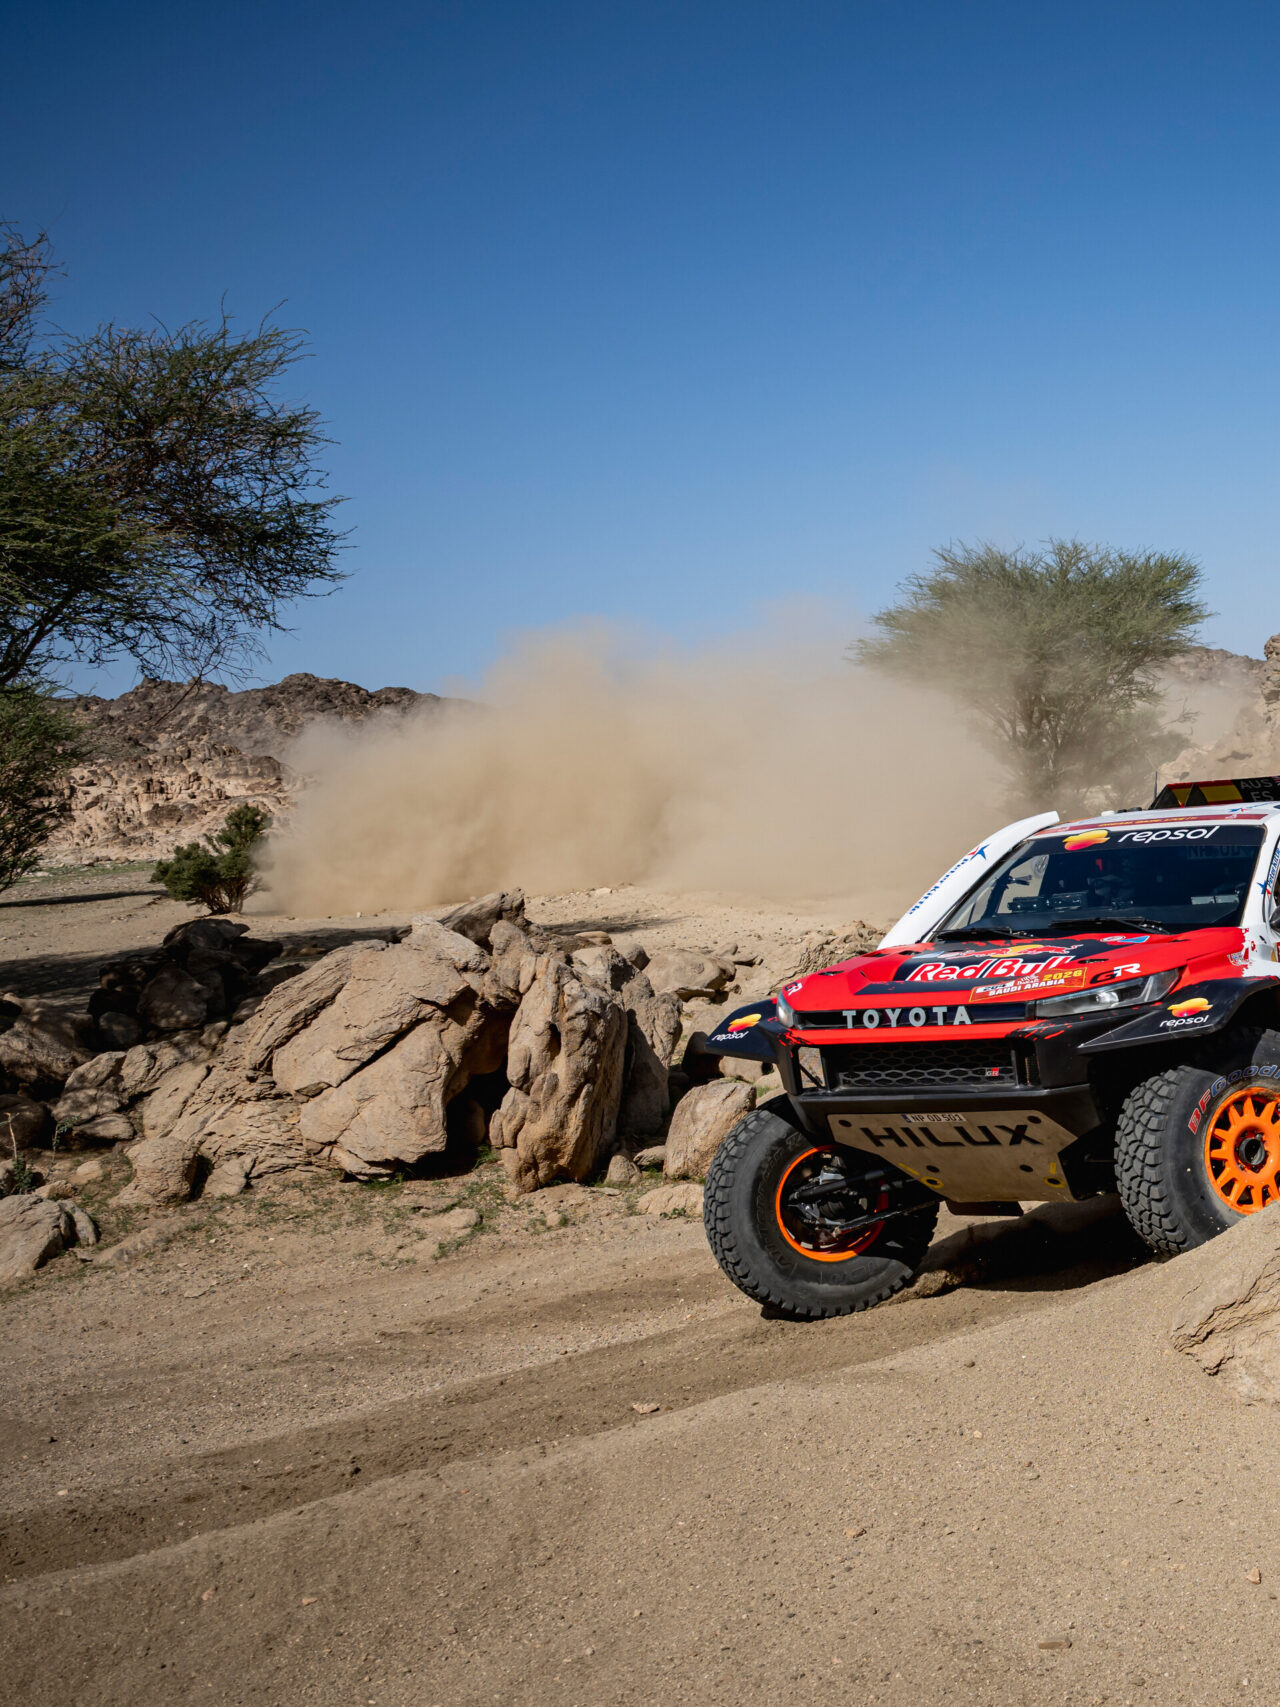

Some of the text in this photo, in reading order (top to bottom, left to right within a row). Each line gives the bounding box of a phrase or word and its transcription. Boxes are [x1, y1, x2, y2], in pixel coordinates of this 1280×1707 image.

[1240, 779, 1273, 789] AUS
[1118, 826, 1220, 843] repsol
[905, 956, 1076, 981] Red Bull
[1042, 970, 1083, 982] 2026
[1090, 963, 1141, 984] GR
[989, 979, 1065, 996] SAUDI ARABIA
[842, 1005, 972, 1029] TOYOTA
[1159, 1015, 1210, 1028] repsol
[859, 1124, 1044, 1148] HILUX
